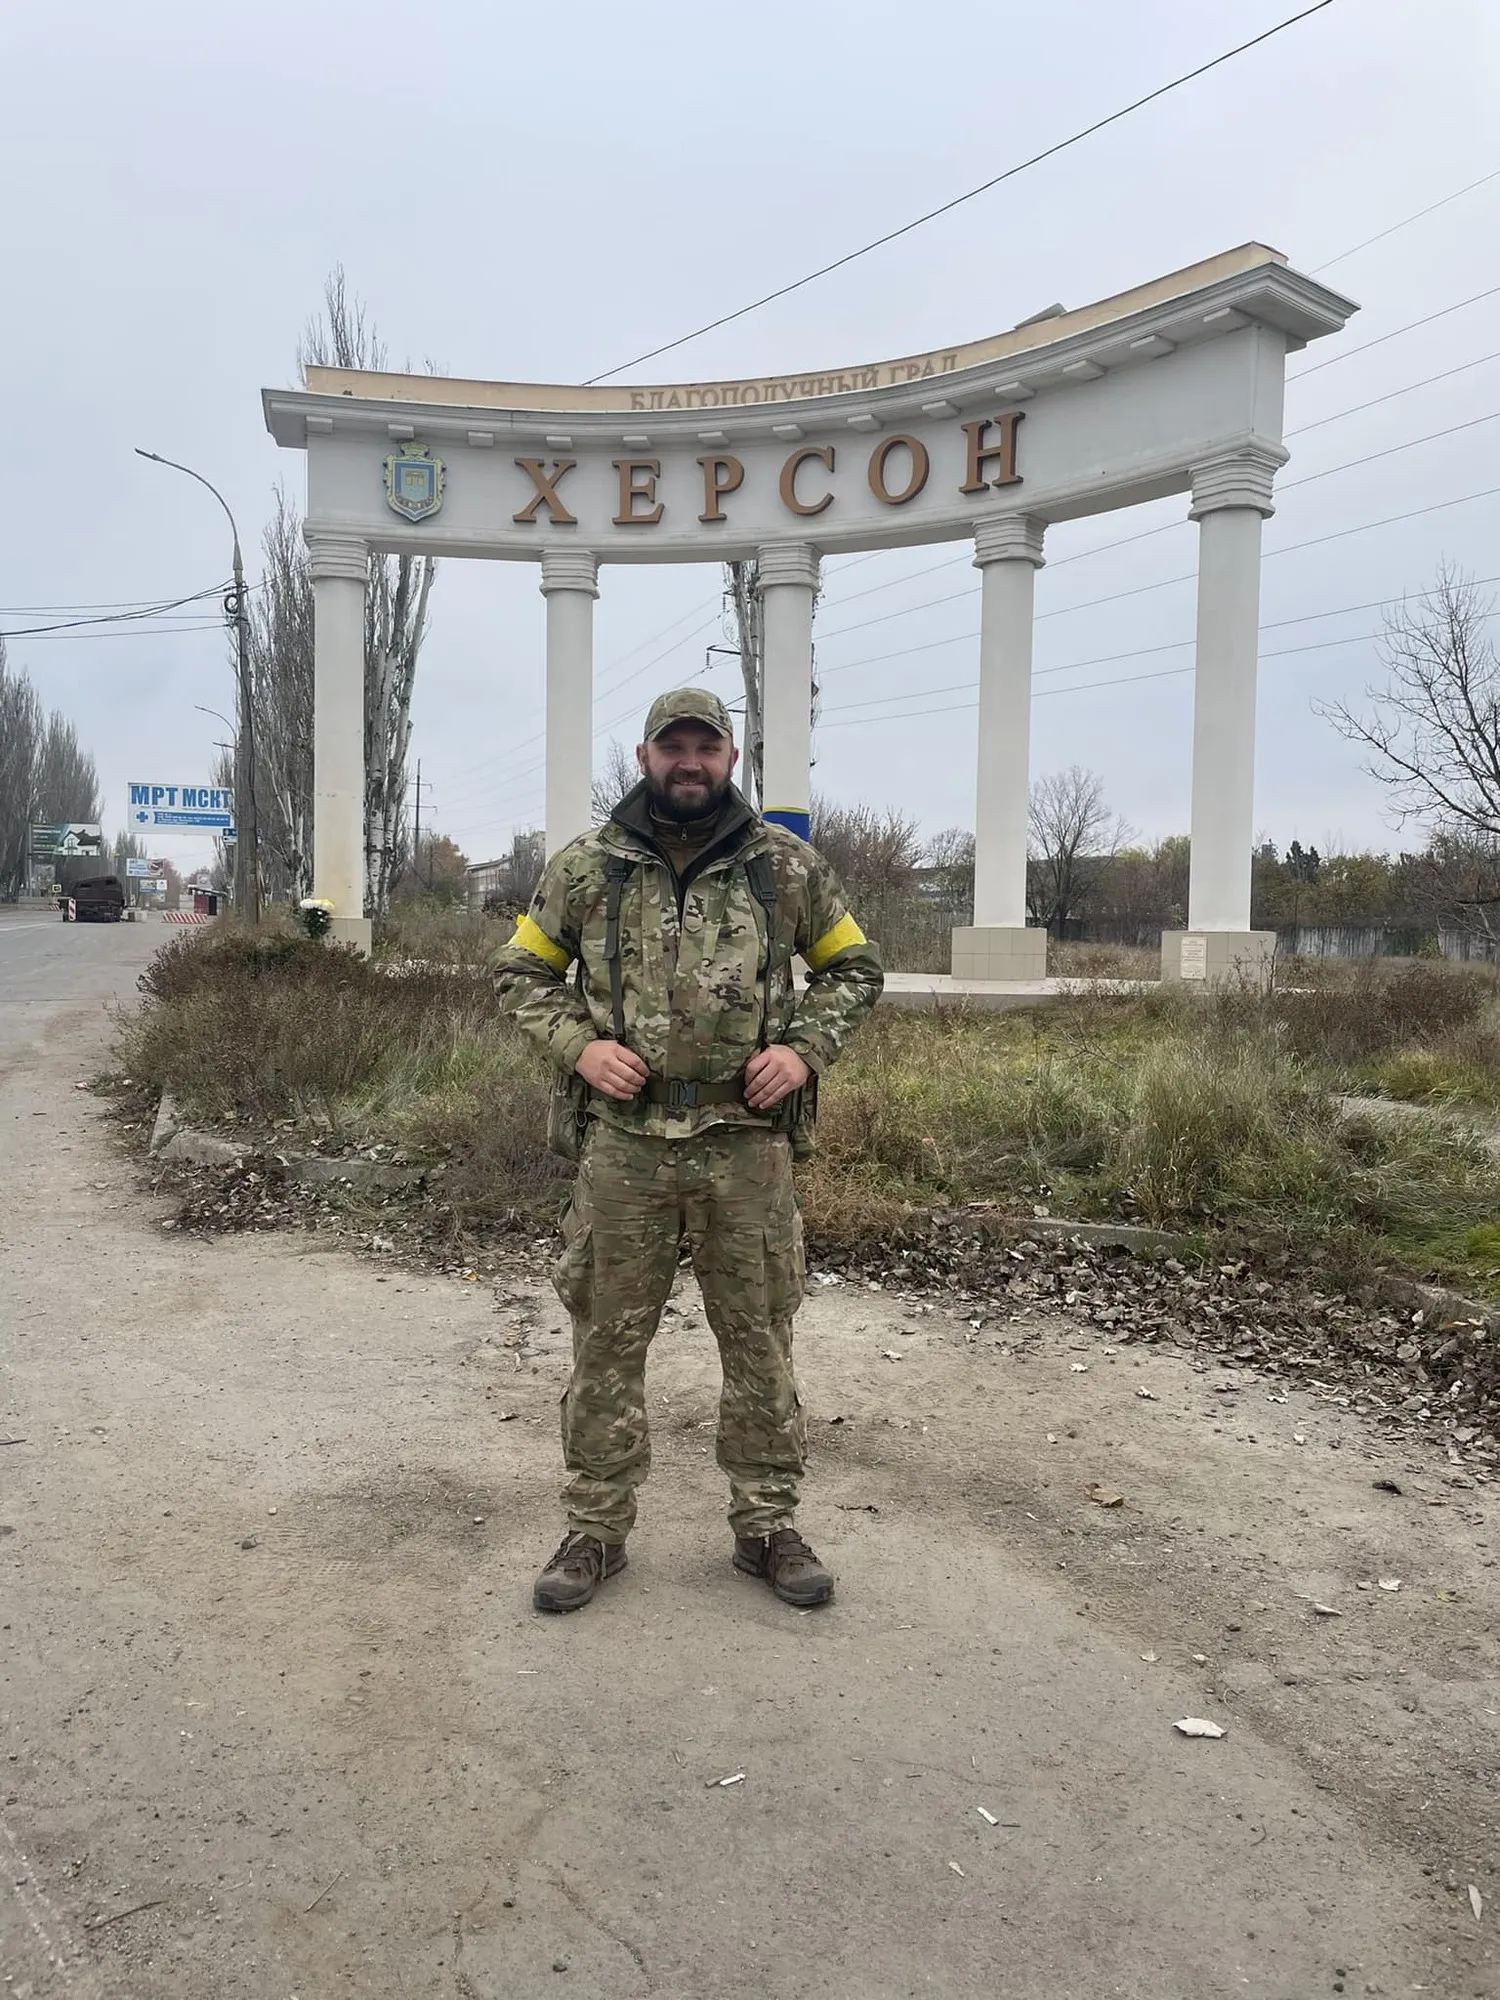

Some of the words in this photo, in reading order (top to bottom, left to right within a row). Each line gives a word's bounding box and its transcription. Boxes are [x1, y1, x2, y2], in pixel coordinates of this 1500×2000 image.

[630, 368, 878, 410] БЛАГОПОЛУЧНЫЙ
[513, 411, 1026, 524] ХЕРСОН
[131, 785, 178, 806] МРТ
[182, 788, 231, 808] МСКТ
